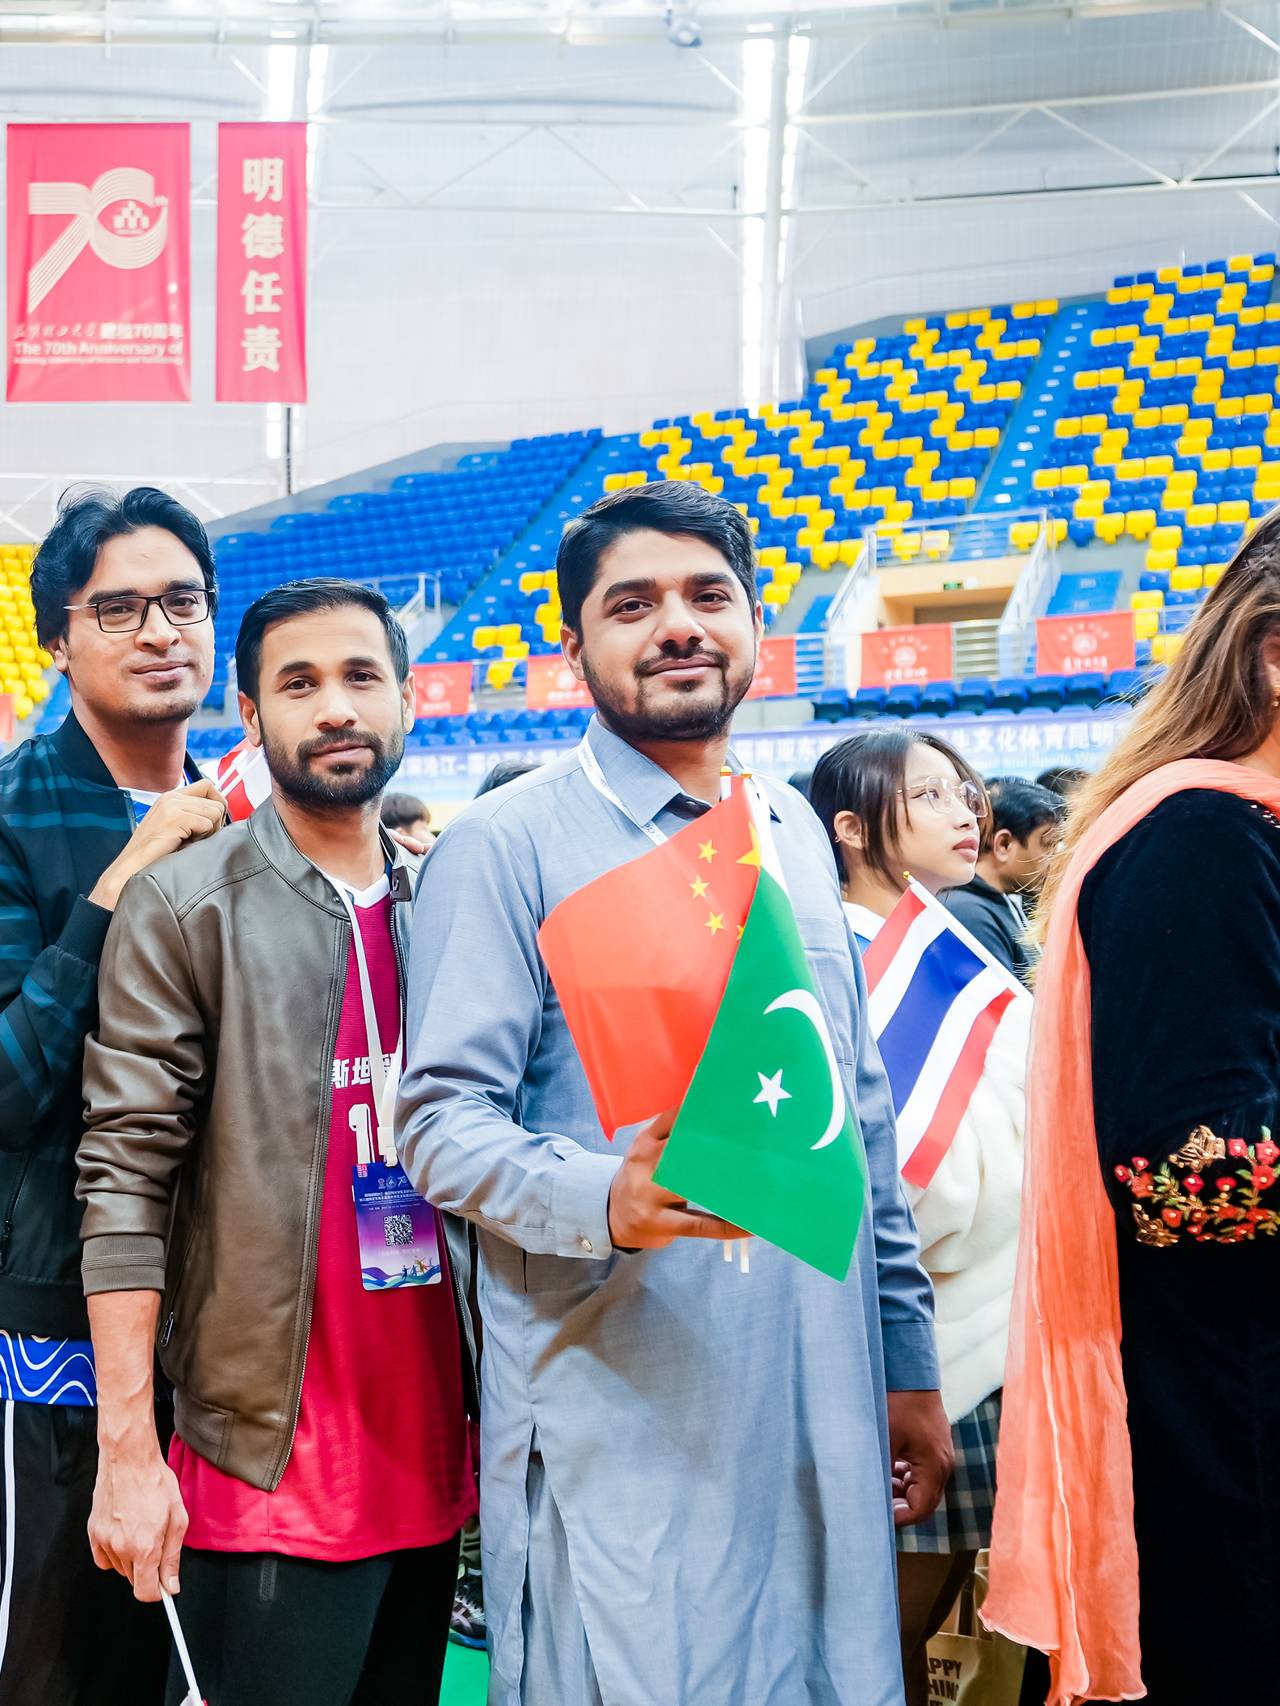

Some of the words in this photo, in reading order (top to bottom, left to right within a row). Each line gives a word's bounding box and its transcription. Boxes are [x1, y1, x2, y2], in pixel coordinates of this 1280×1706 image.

[240, 157, 284, 373] 明德任责
[15, 342, 40, 356] The
[43, 342, 77, 355] 70th
[79, 342, 165, 358] Anniversary
[167, 341, 184, 355] of
[928, 1657, 962, 1679] PPY
